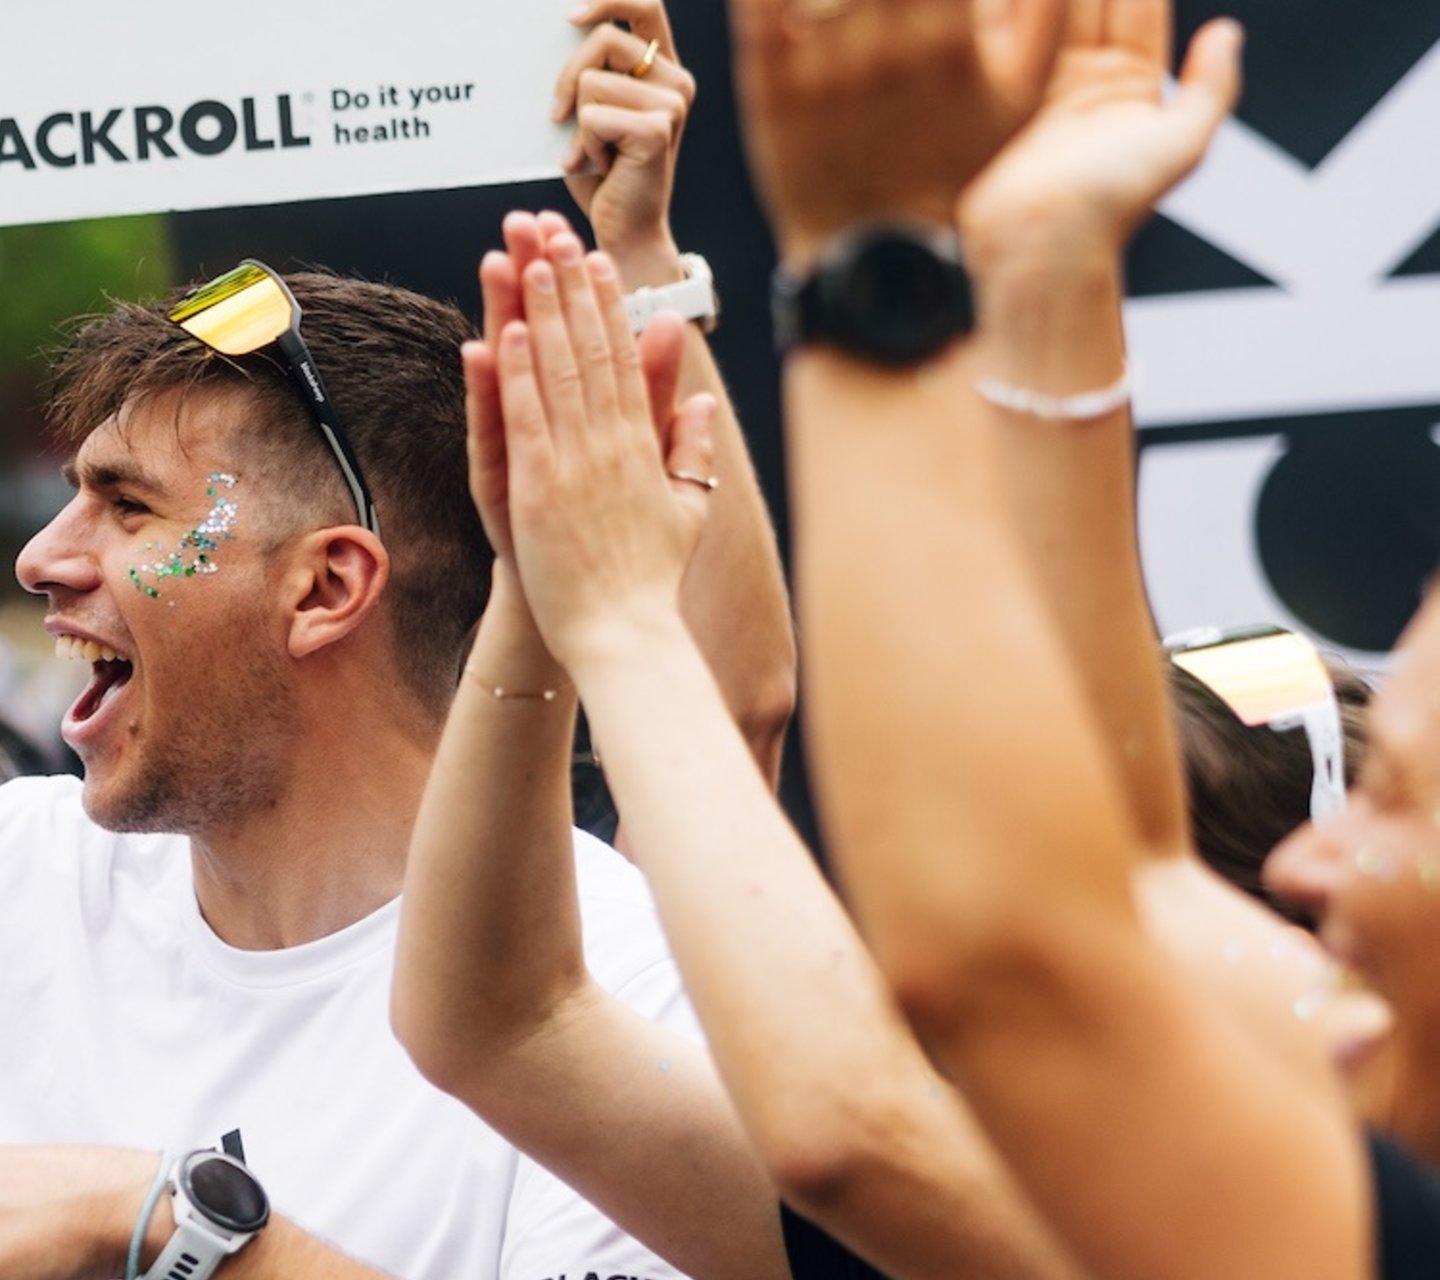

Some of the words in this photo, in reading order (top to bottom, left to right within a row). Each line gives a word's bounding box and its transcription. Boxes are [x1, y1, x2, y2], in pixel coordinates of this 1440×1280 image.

[332, 89, 370, 112] Do
[378, 86, 400, 108] it
[409, 81, 476, 110] your
[334, 116, 431, 145] health
